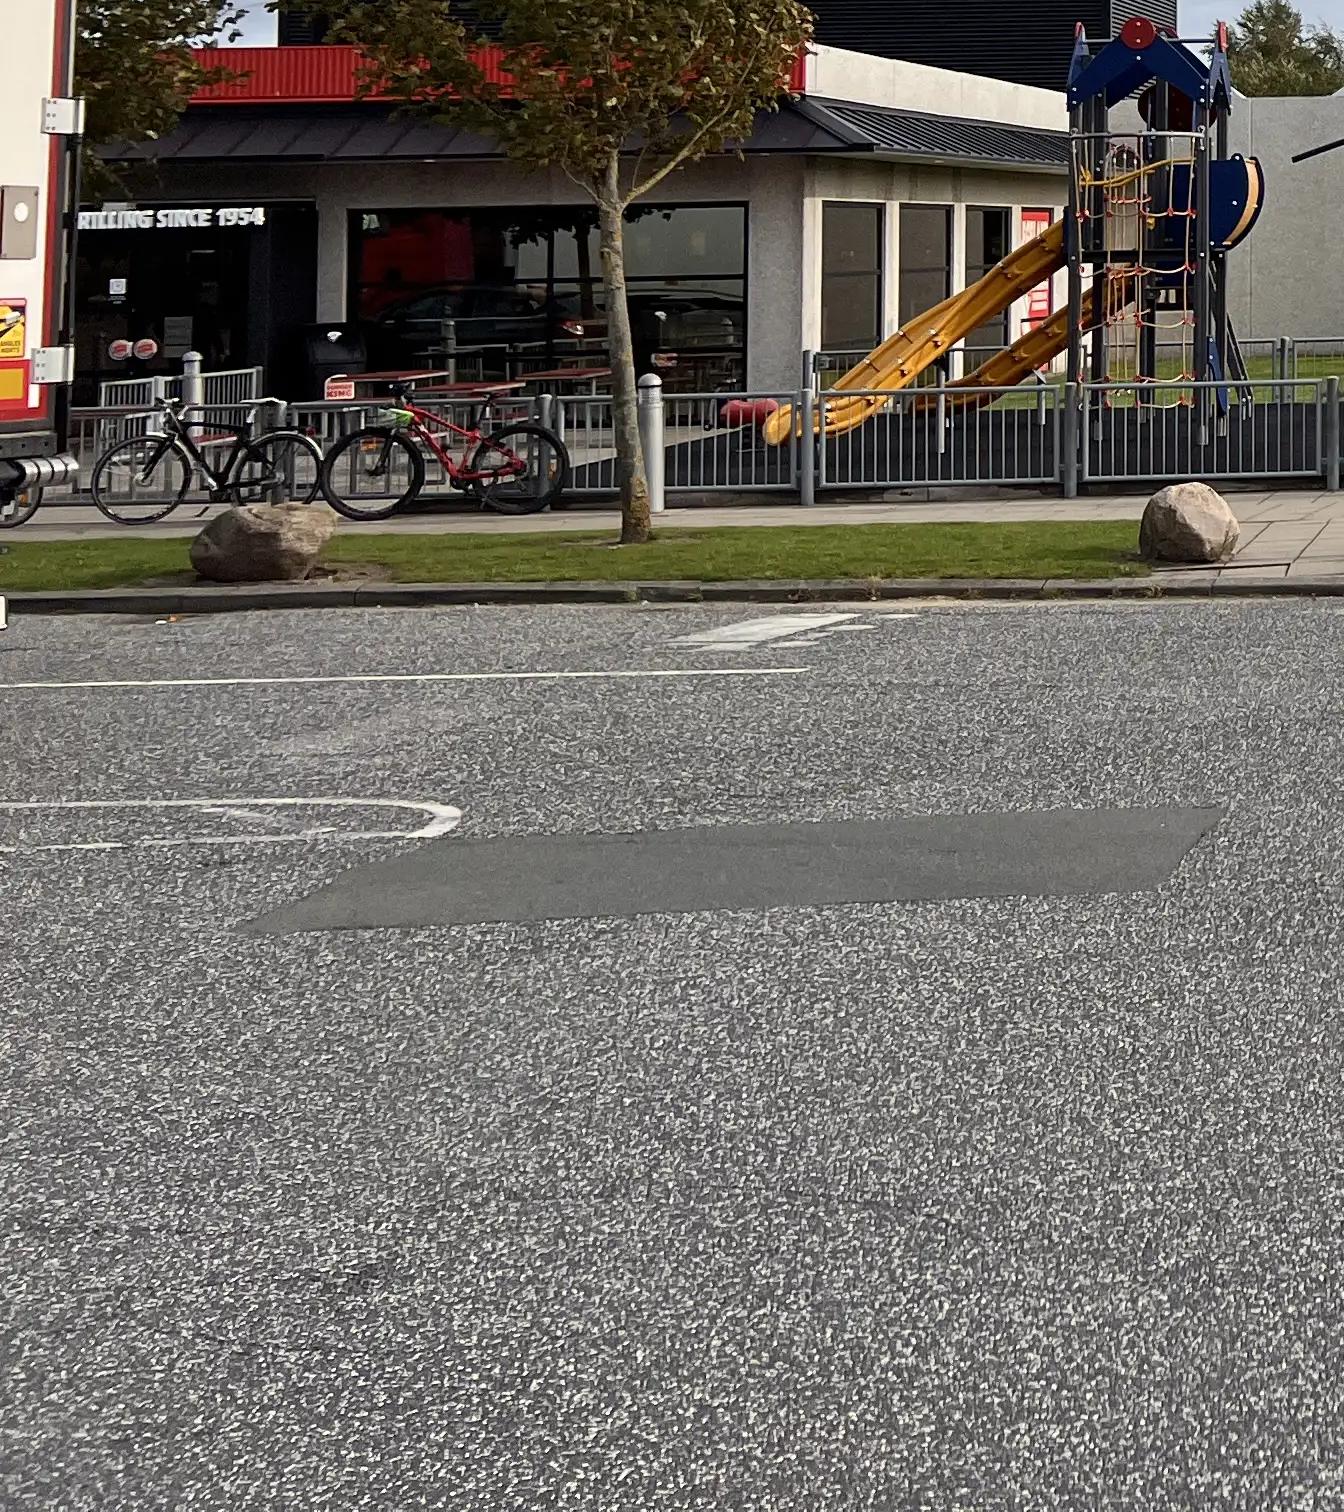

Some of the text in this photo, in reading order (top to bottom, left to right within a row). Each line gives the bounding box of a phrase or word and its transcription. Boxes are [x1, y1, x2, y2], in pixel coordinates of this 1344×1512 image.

[78, 207, 266, 229] RILLING SINCE 1954
